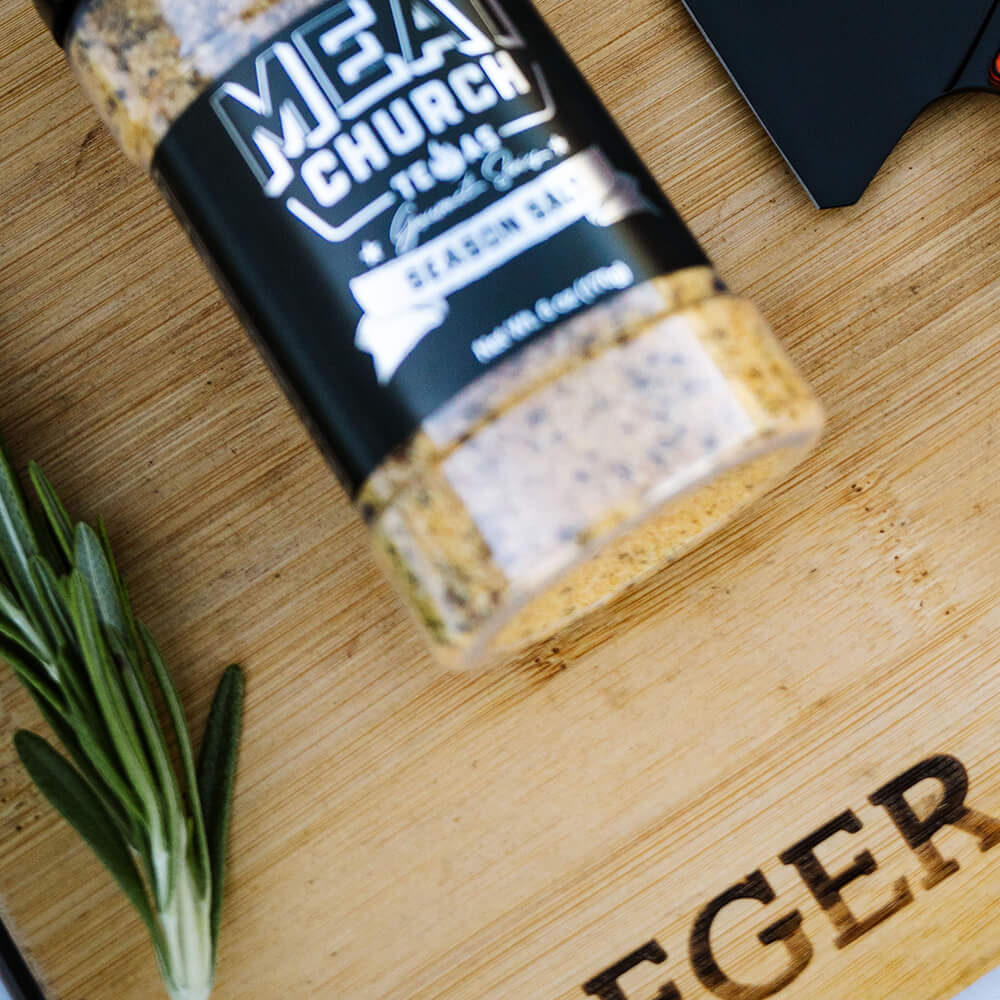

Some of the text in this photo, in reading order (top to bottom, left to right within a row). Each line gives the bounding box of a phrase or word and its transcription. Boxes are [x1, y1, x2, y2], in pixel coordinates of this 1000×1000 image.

[300, 50, 531, 207] CHURCH
[407, 176, 577, 289] SEASON SAL
